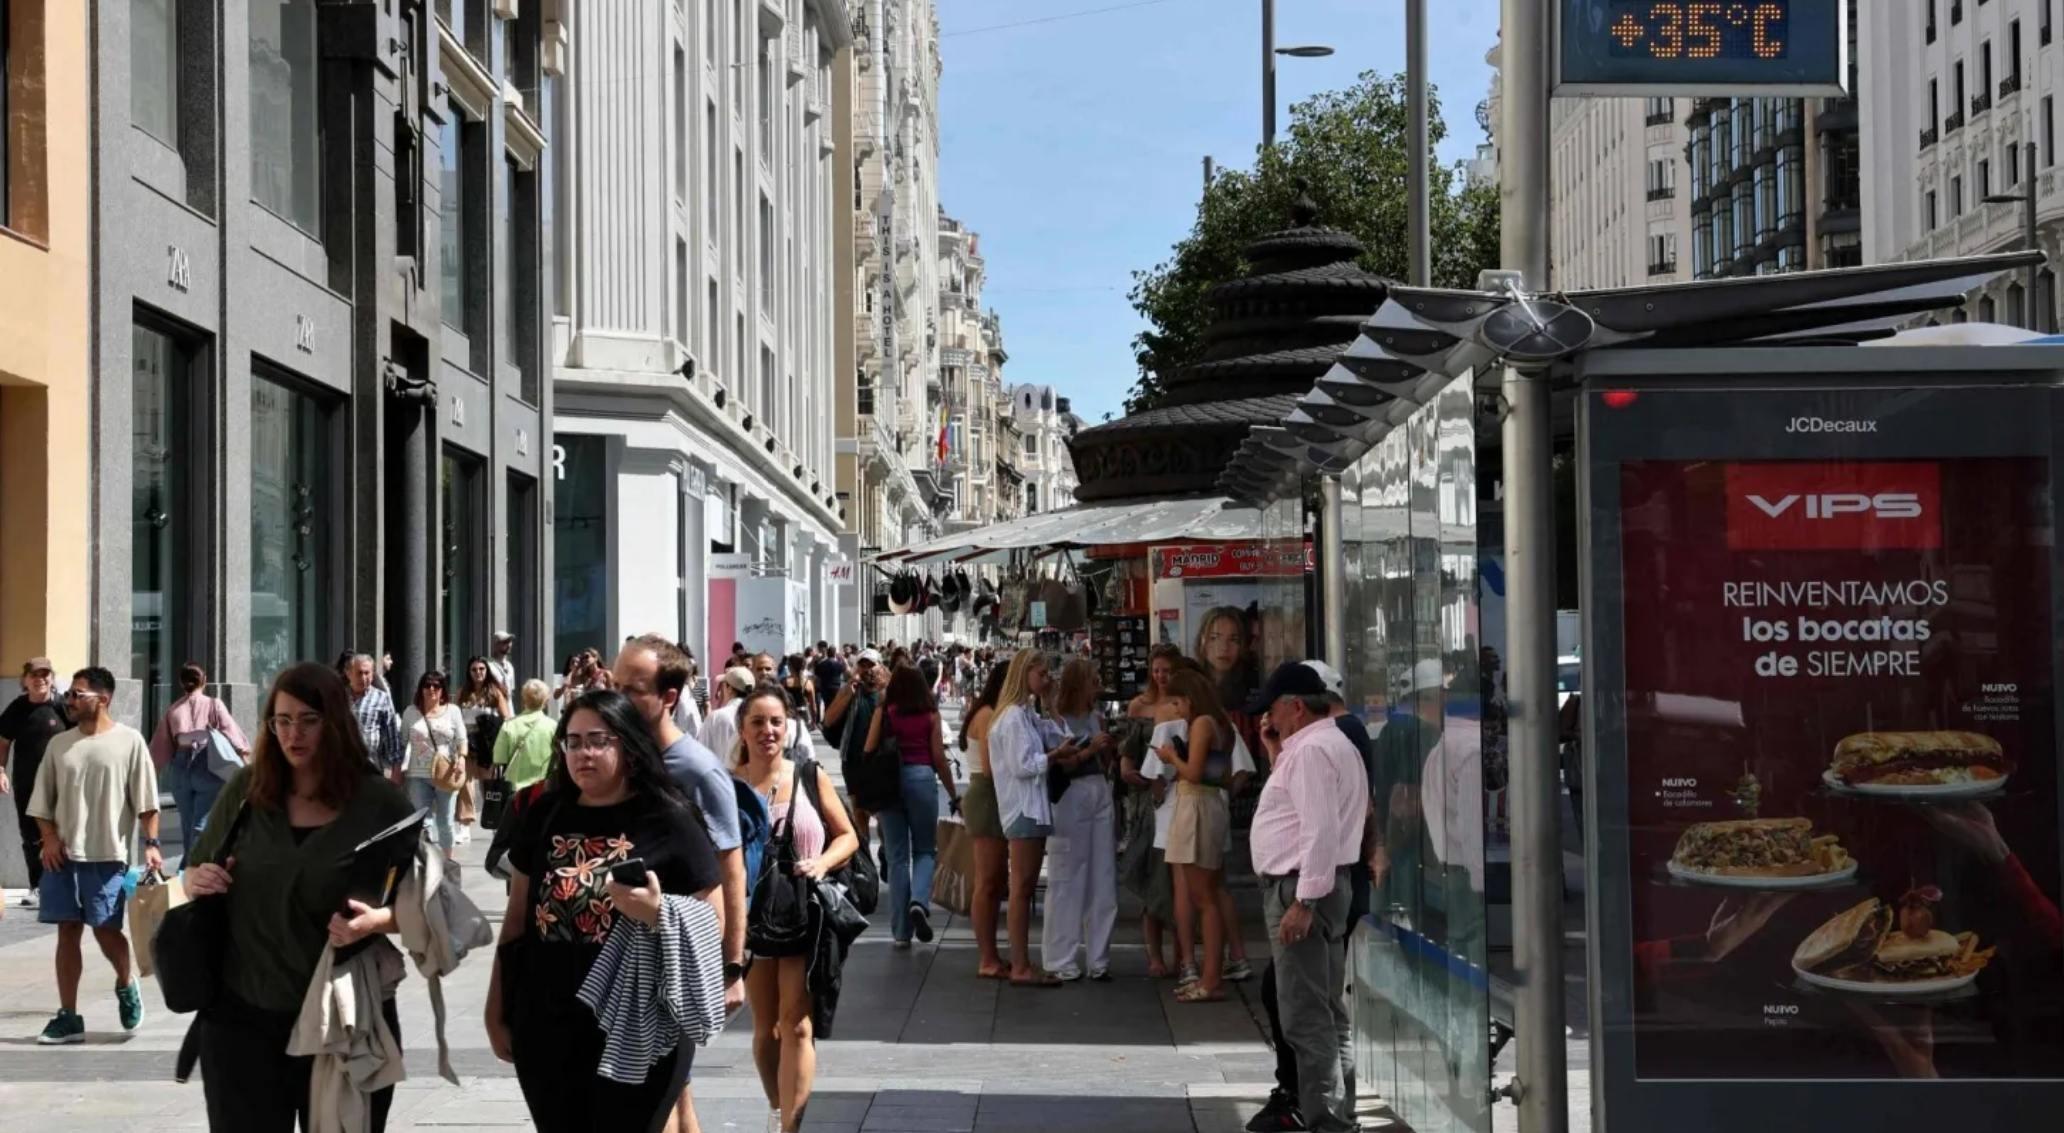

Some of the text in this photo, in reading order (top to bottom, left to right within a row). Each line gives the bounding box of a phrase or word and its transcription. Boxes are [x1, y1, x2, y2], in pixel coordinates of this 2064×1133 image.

[881, 215, 892, 357] THIS IS A HOTEL
[1785, 417, 1878, 433] JCDecaux
[1744, 493, 1922, 519] VIPS
[1171, 552, 1220, 567] MADRID
[1723, 580, 1949, 607] REINVENTAMOS
[1743, 615, 1931, 642] los bocatas
[1754, 651, 1921, 677] de SIEMPRE
[1981, 683, 2018, 693] NUEVO
[1662, 778, 1698, 788] NUEVO
[1763, 1004, 1800, 1015] NUEVO
